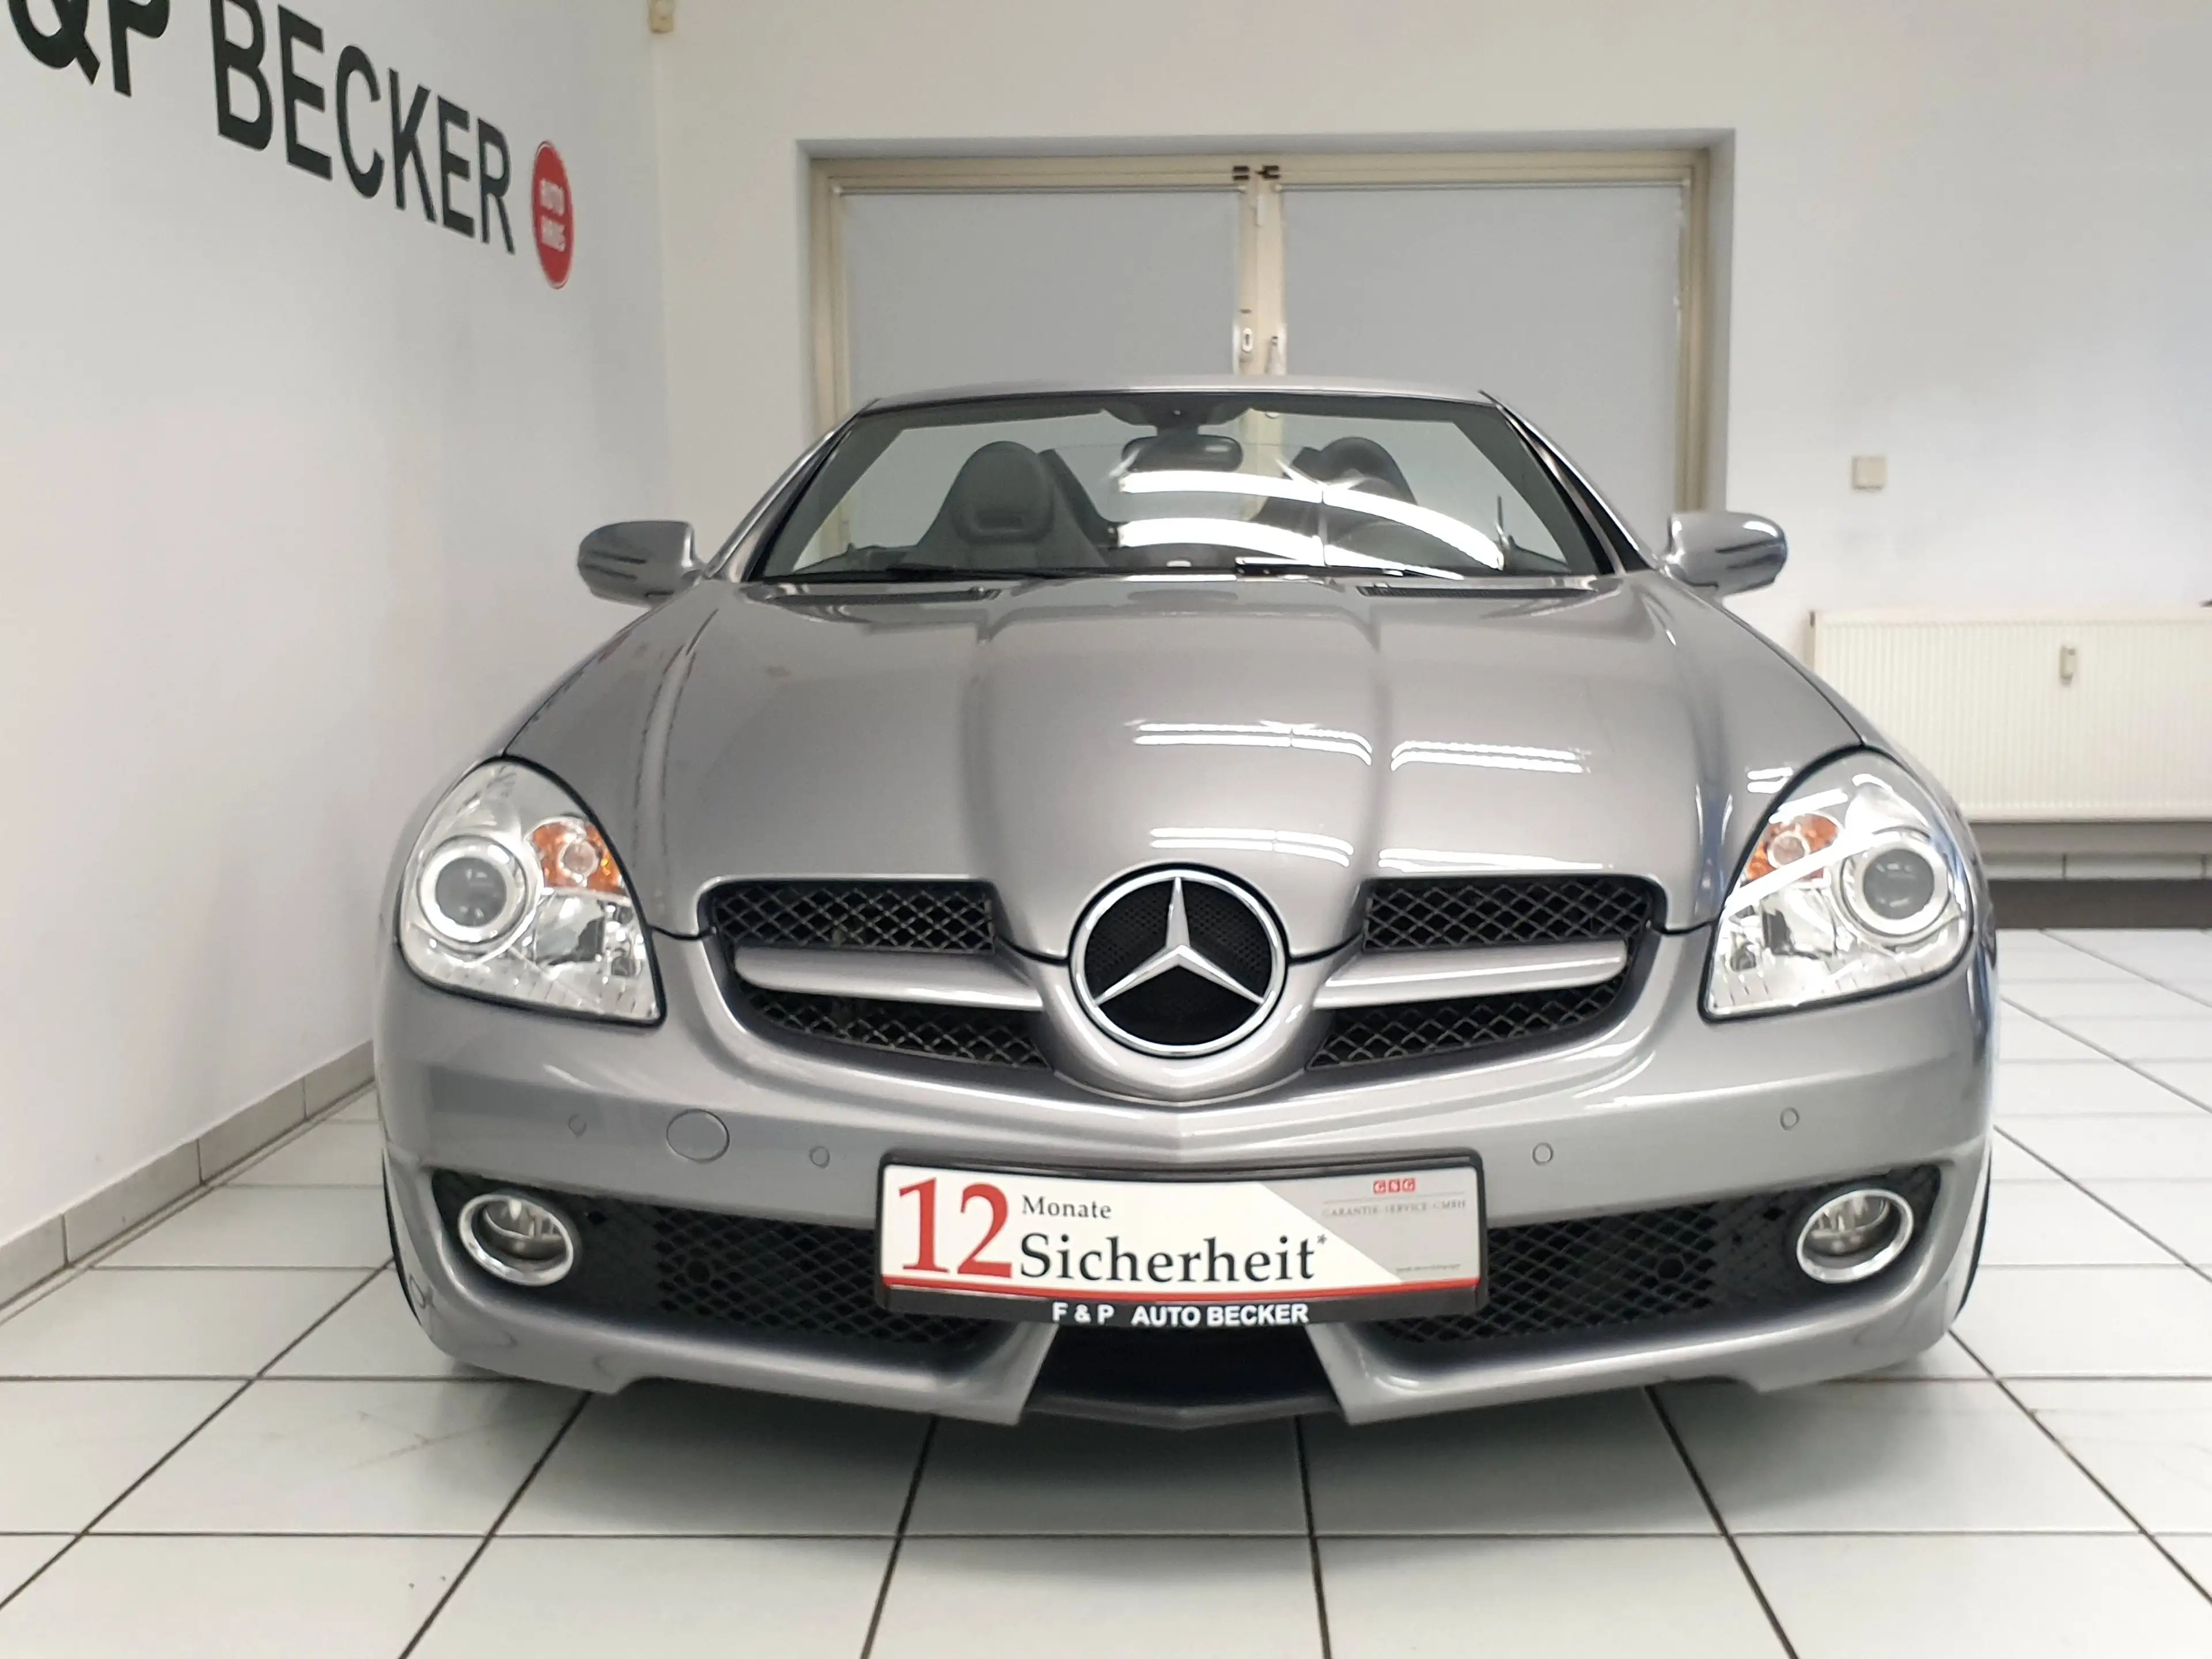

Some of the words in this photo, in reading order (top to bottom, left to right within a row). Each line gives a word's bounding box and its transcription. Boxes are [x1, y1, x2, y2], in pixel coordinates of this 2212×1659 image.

[210, 0, 516, 255] BECKER
[899, 1177, 1013, 1278] 12
[1021, 1194, 1112, 1219] Monate
[1052, 1302, 1068, 1321] F
[1074, 1304, 1092, 1323] &
[1097, 1304, 1114, 1323] P
[1131, 1305, 1201, 1327] AUTO
[1207, 1303, 1309, 1327] BECKER
